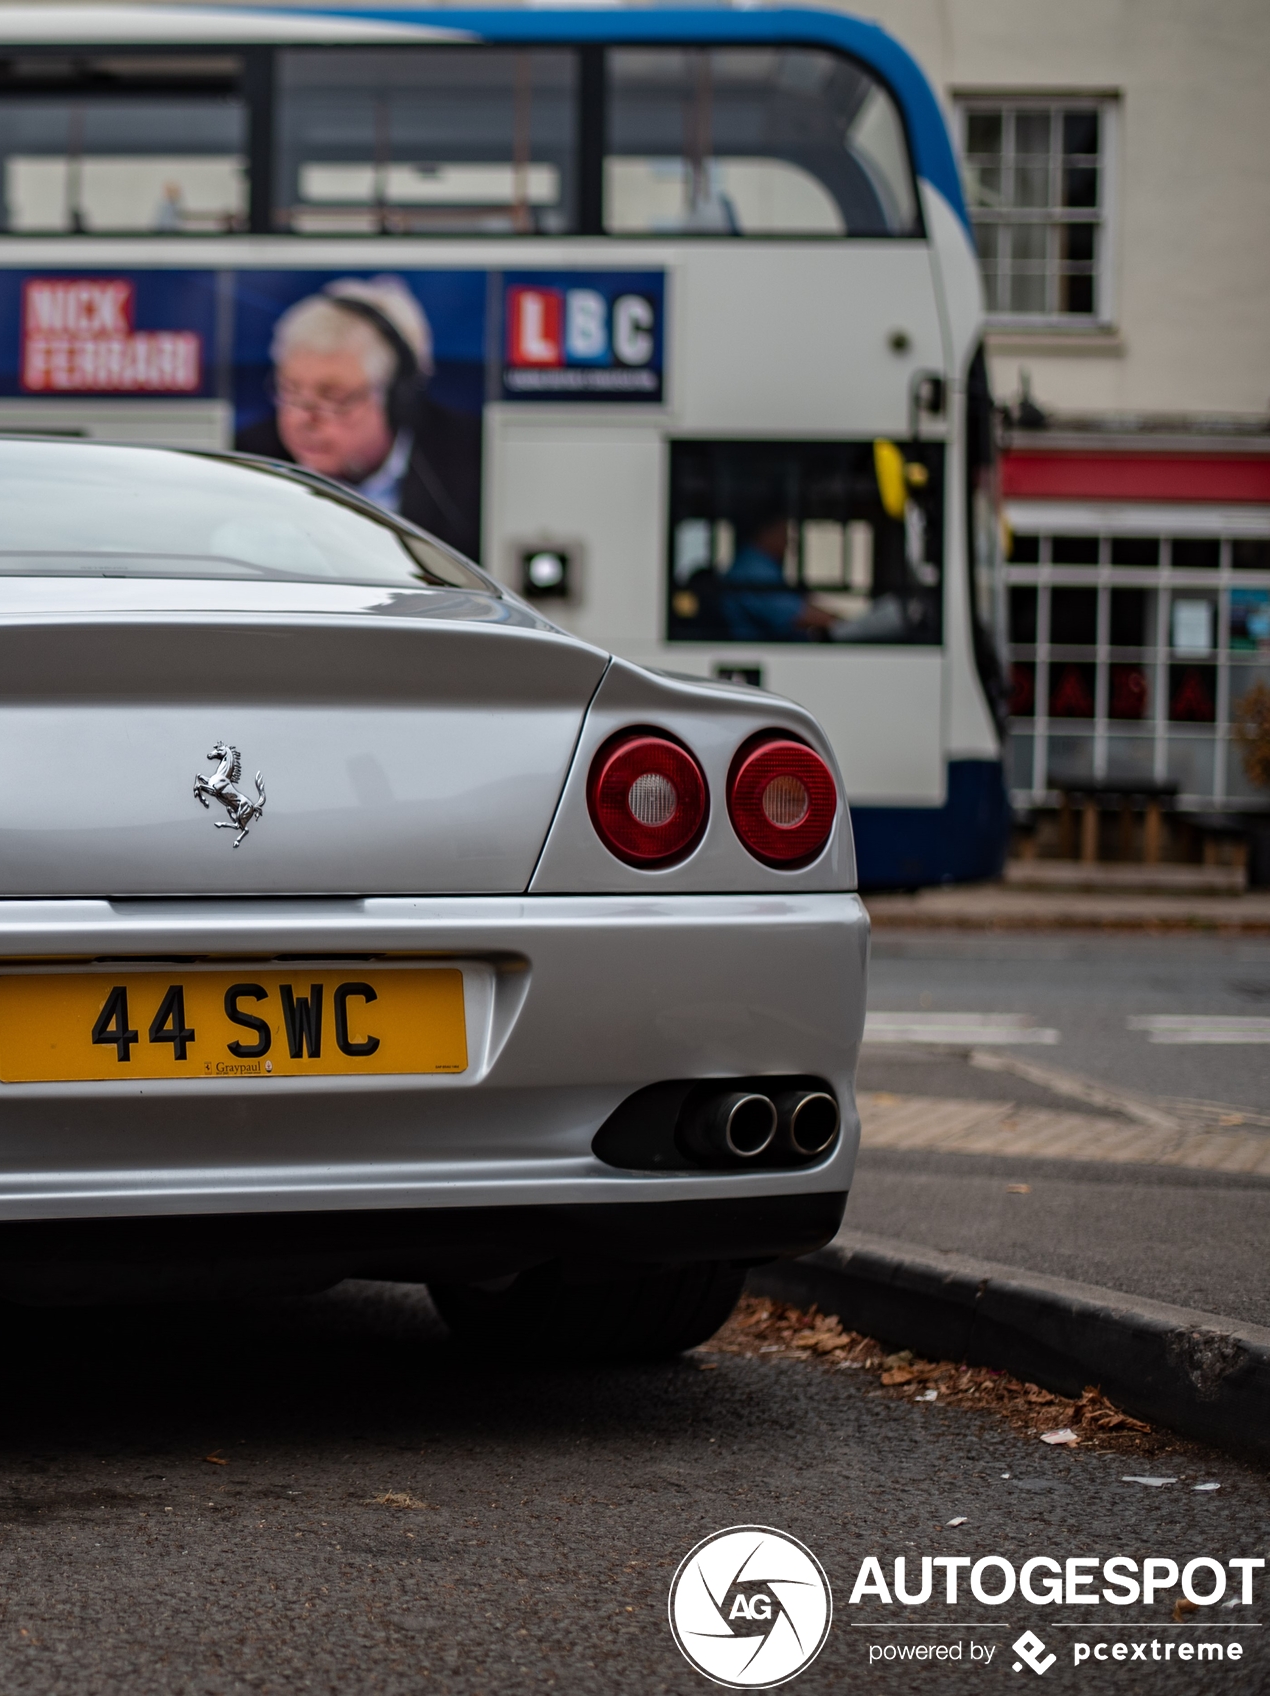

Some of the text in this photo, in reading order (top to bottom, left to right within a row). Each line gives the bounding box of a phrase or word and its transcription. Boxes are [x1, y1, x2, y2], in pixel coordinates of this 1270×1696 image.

[27, 281, 130, 332] NICK
[520, 288, 655, 366] LBC
[26, 332, 199, 391] FERRARI
[91, 982, 380, 1062] 44 SWC
[215, 1061, 261, 1075] Graypaul
